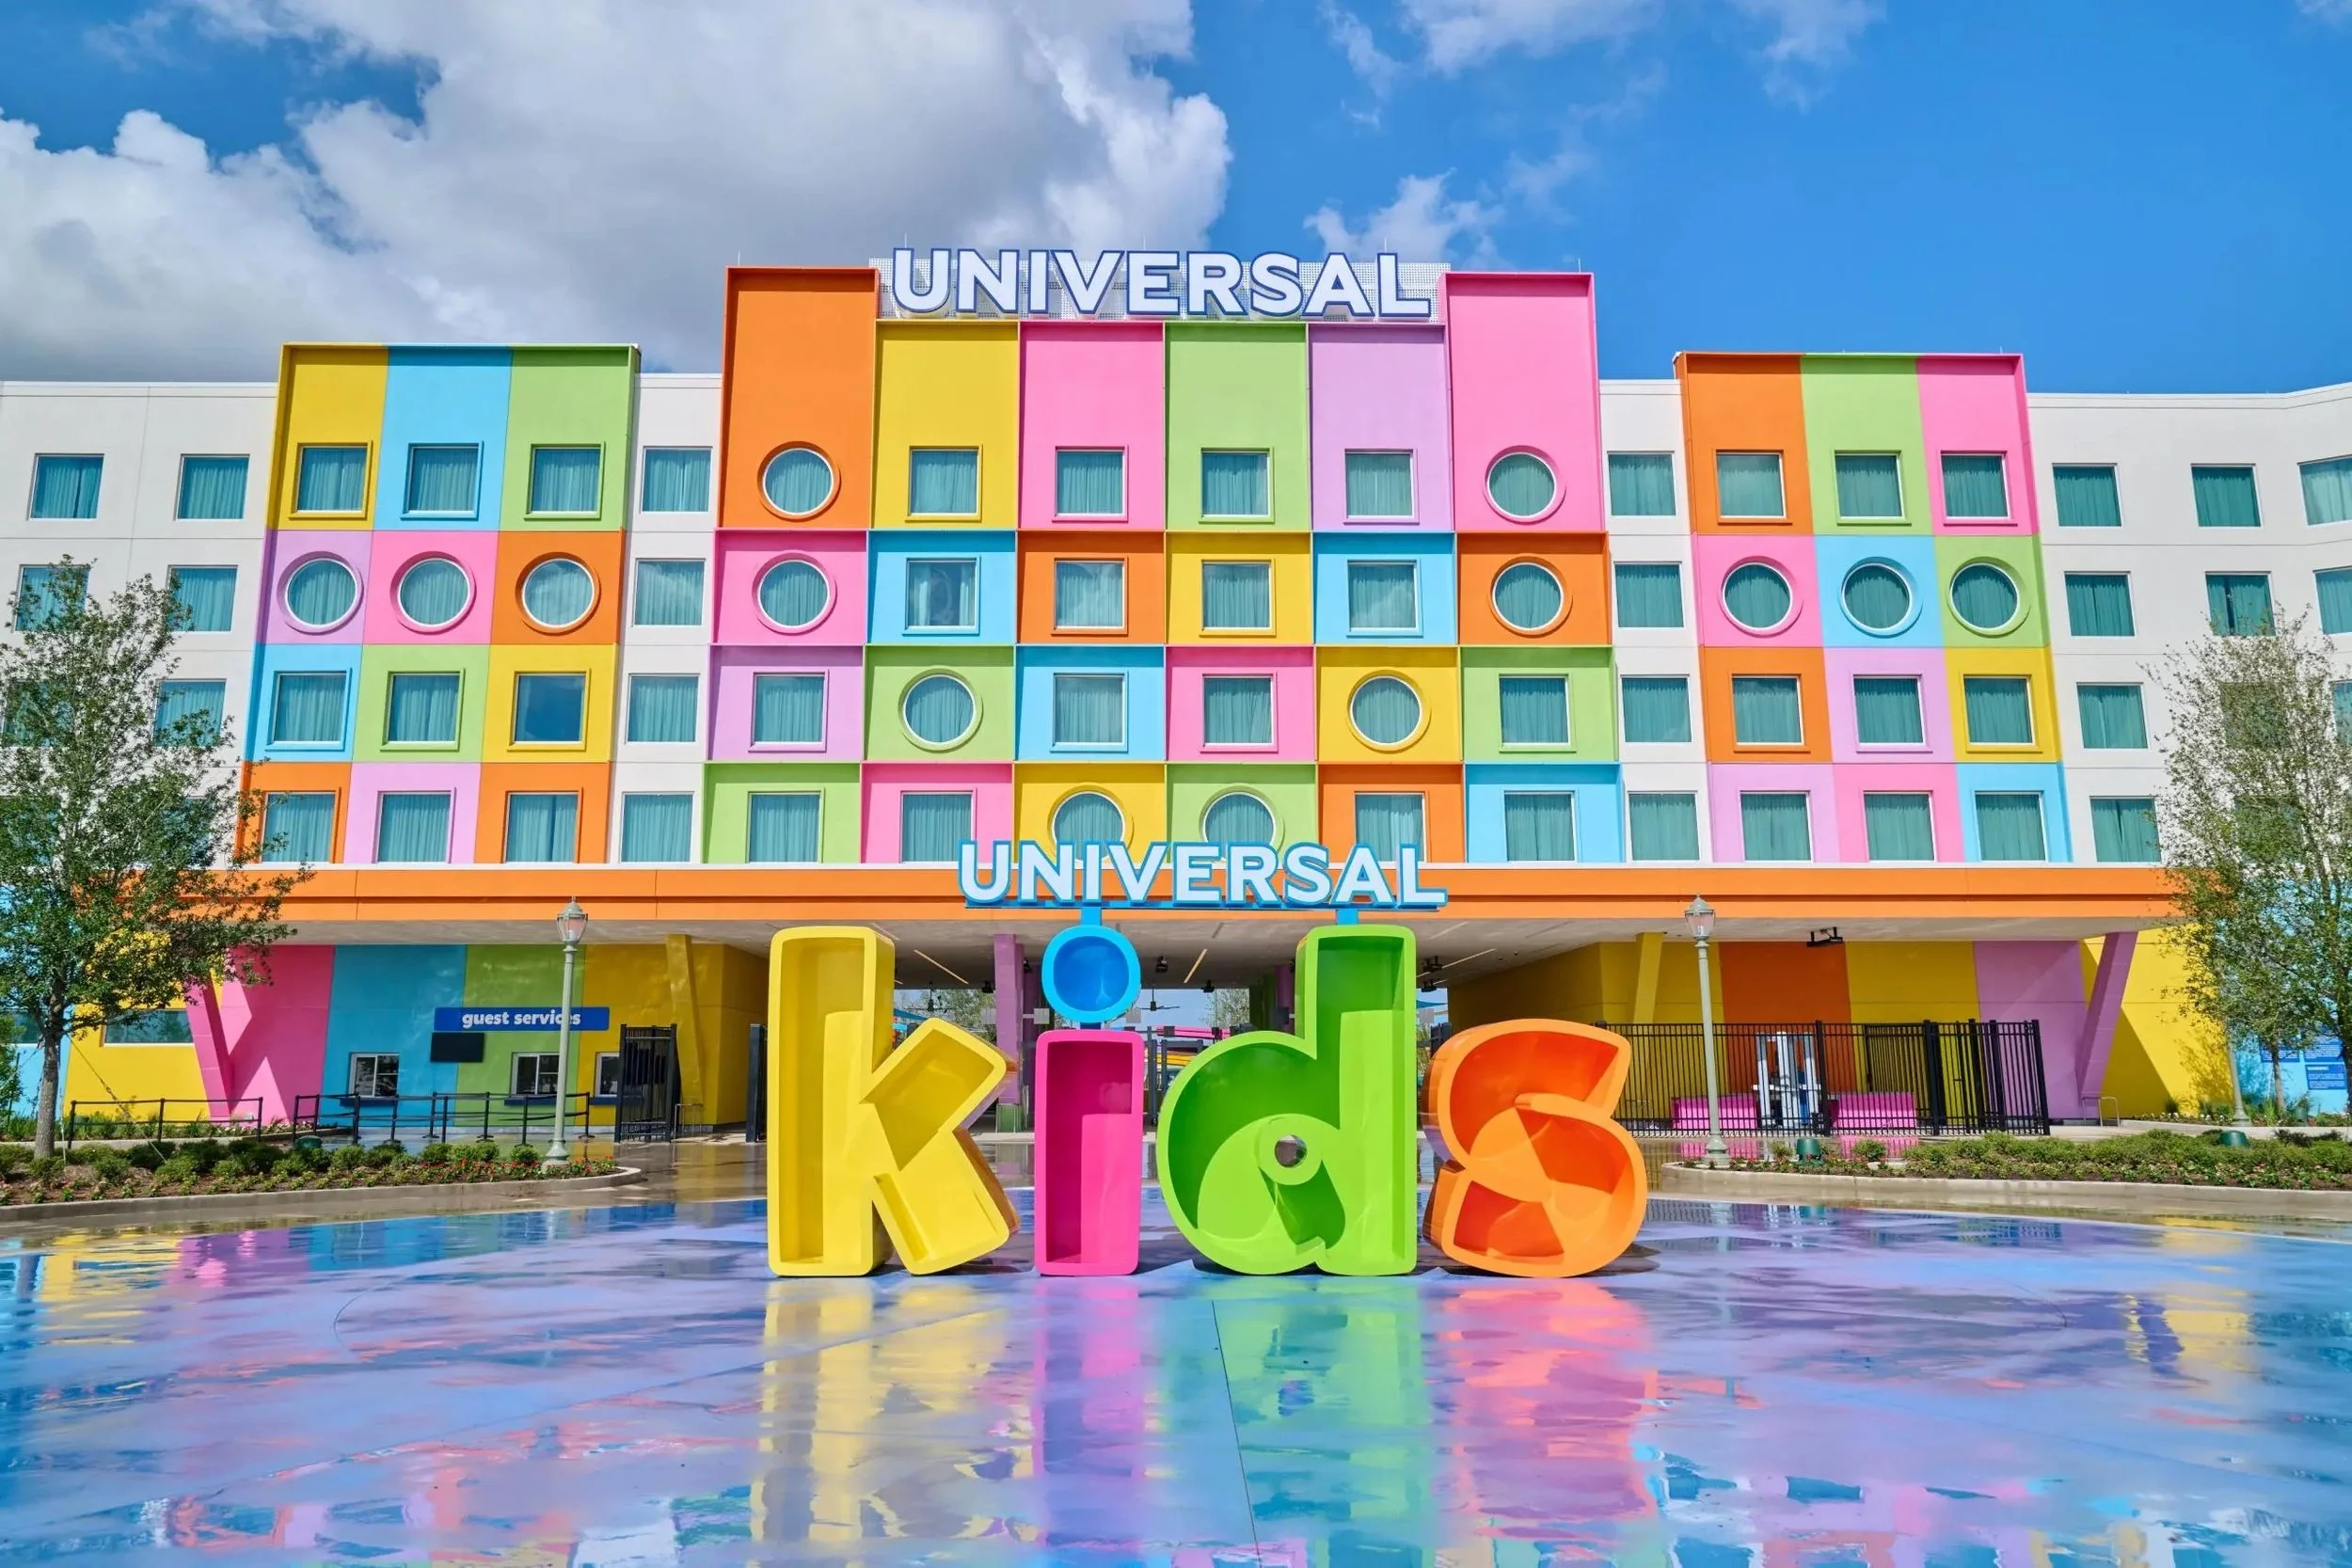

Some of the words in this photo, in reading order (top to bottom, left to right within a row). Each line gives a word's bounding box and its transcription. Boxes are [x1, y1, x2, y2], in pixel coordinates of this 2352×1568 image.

[893, 247, 1431, 317] UNIVERSAL
[958, 840, 1447, 906] UNIVERSAL
[462, 1011, 509, 1028] guest
[768, 925, 1648, 1277] kids
